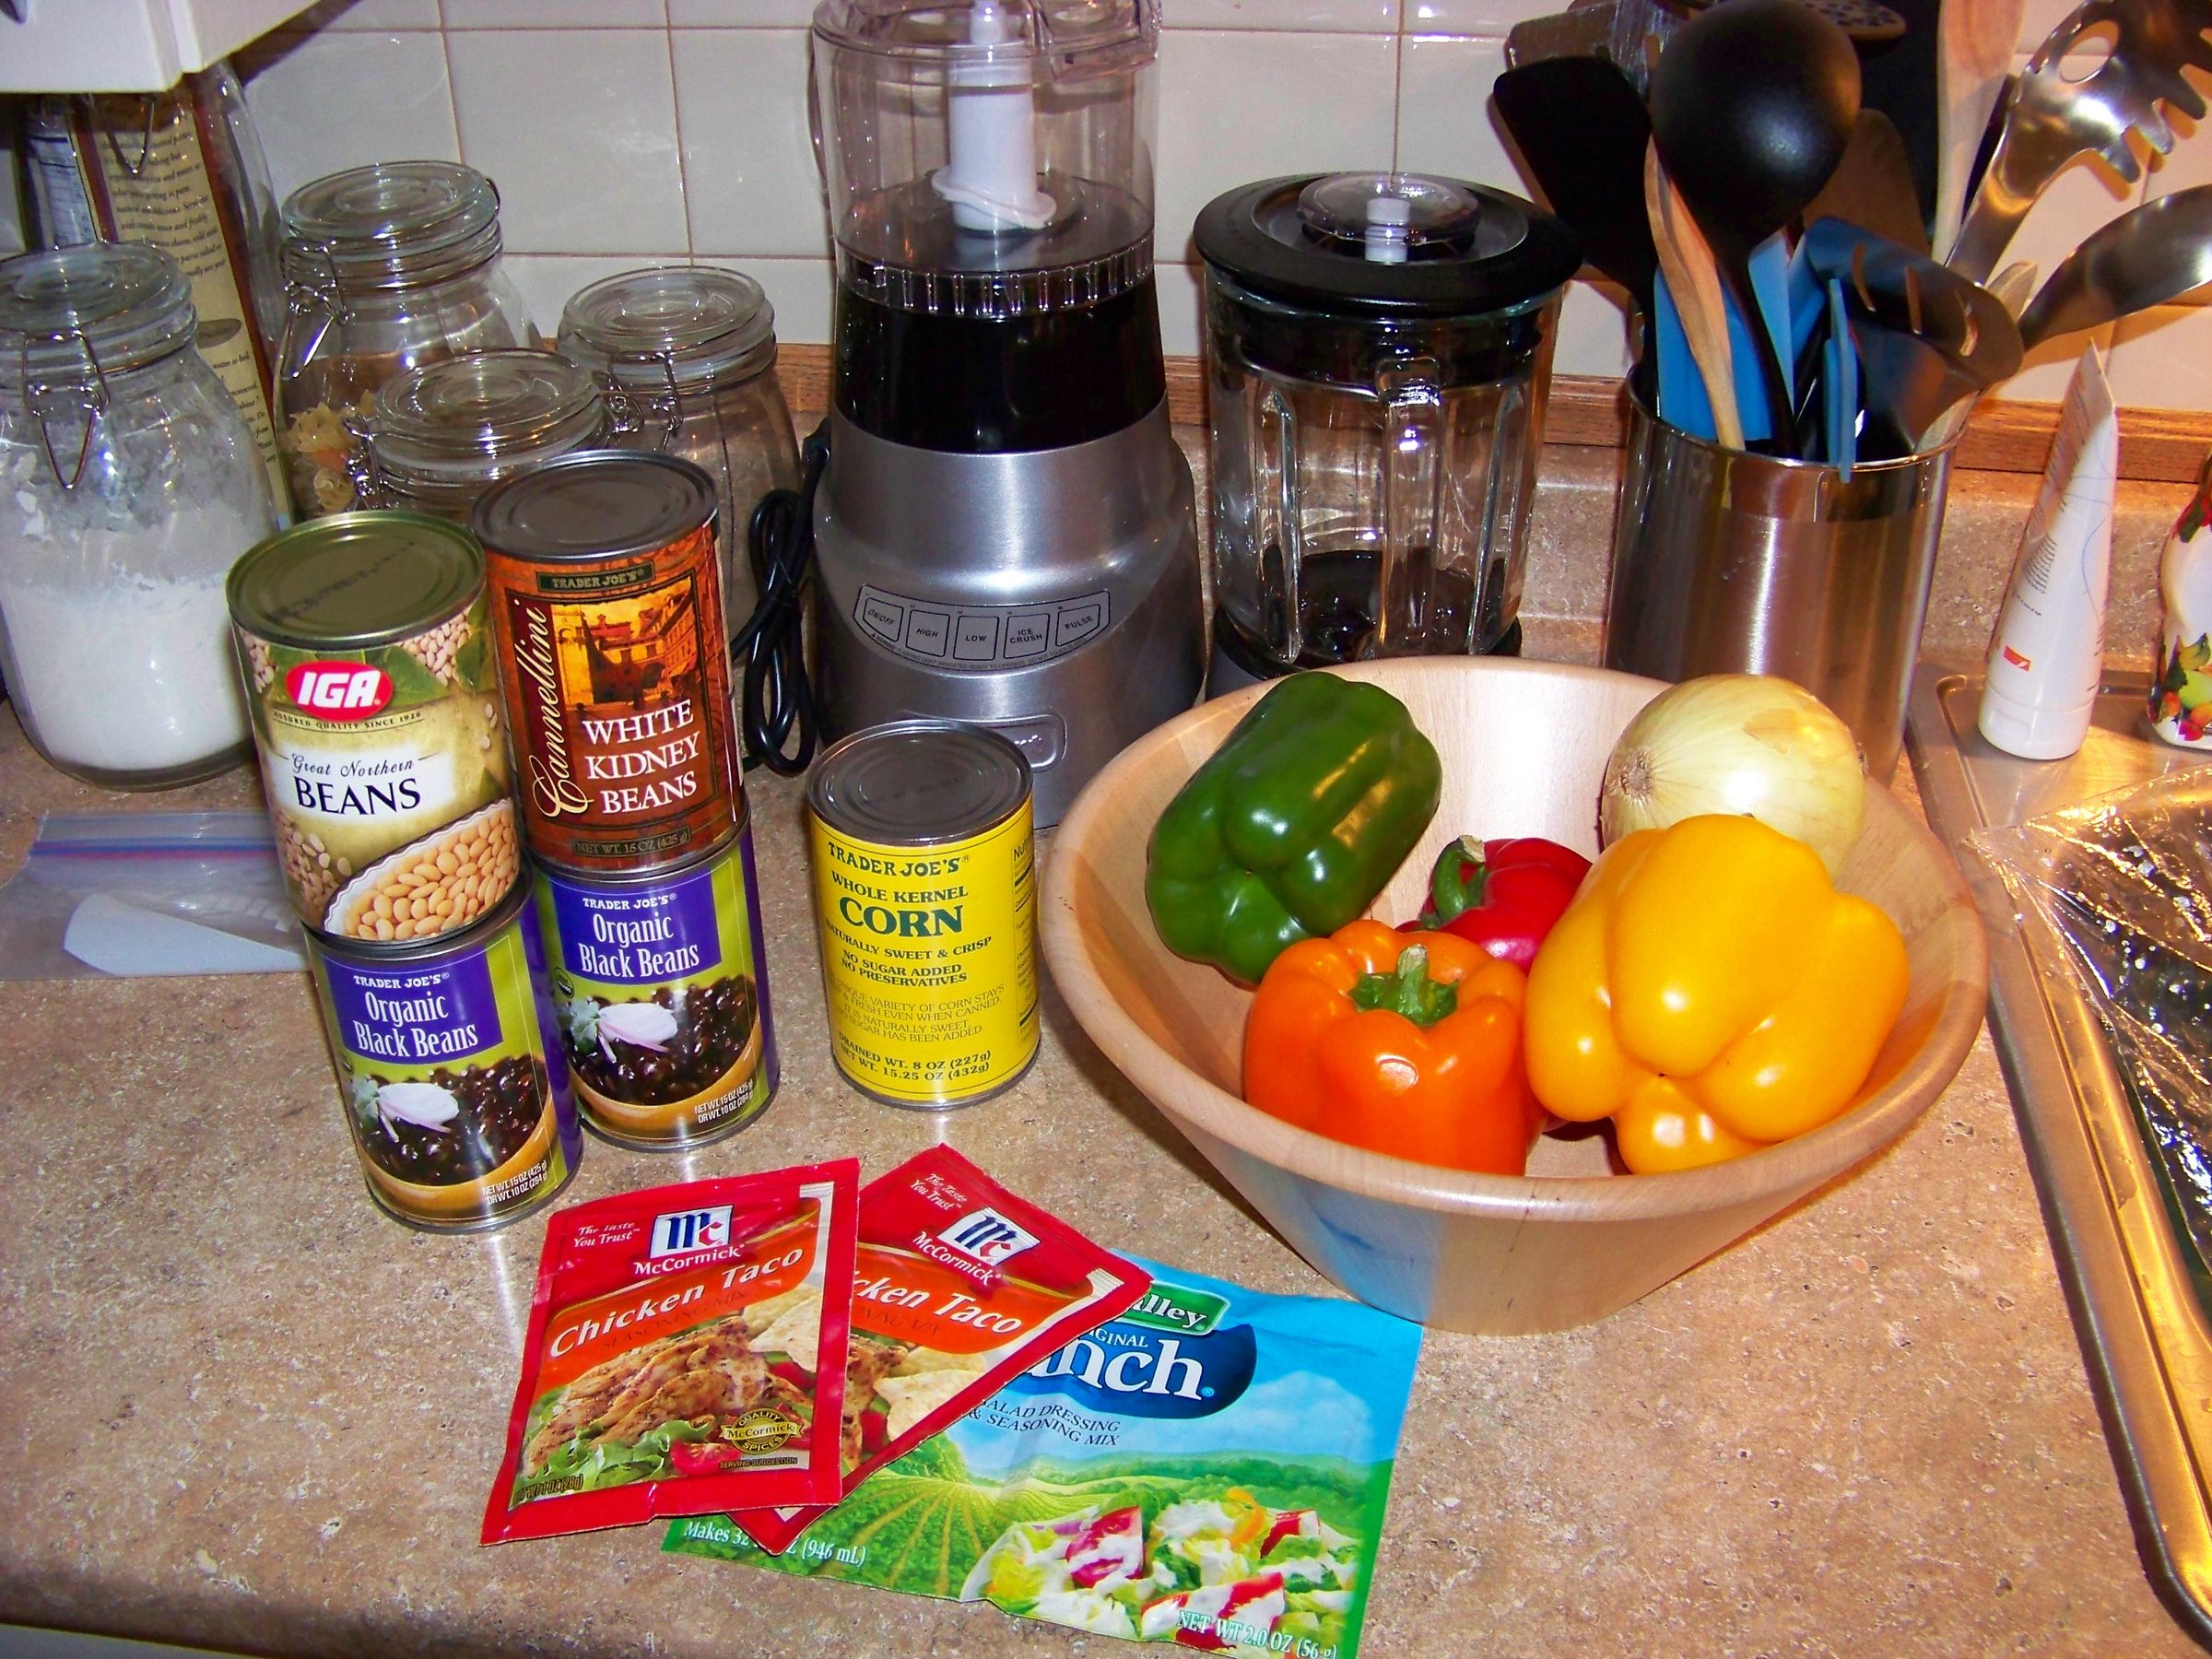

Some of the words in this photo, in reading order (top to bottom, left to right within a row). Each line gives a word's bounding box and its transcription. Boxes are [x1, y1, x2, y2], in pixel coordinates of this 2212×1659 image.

[552, 578, 601, 589] TRADER
[916, 628, 939, 638] HIGH
[1018, 628, 1033, 636] ICE
[1064, 615, 1094, 629] PULSE
[1009, 634, 1043, 644] CRUSH
[298, 670, 381, 708] IGA
[274, 711, 311, 726] ASSURED
[316, 721, 359, 730] QUALITY
[365, 718, 394, 728] SINCE
[582, 699, 694, 746] WHITE
[291, 753, 331, 775] Great
[340, 759, 413, 777] Northern
[585, 731, 700, 780] KIDNEY
[293, 775, 421, 815] BEANS
[600, 771, 698, 815] BEANS
[576, 841, 598, 853] NET
[638, 840, 656, 852] OZ
[828, 841, 897, 877] TRADER
[900, 857, 960, 877] JOE'S
[831, 870, 888, 901] WHOLE
[894, 886, 969, 903] KERNEL
[582, 898, 630, 910] TRADER
[633, 895, 669, 909] JOE'S
[593, 912, 674, 948] Organic
[840, 896, 964, 937] CORN
[578, 942, 635, 978] Black
[636, 944, 700, 978] Beans
[885, 948, 933, 959] SWEET
[937, 949, 948, 959] &
[953, 935, 993, 956] CRISP
[841, 958, 856, 972] NO
[859, 969, 967, 987] PRESERVATIVES
[843, 950, 859, 963] NO
[862, 959, 907, 976] SUGAR
[911, 964, 961, 977] ADDED
[353, 975, 402, 989] TRADER
[404, 973, 441, 988] JOE'S
[365, 991, 449, 1028] Organic
[870, 996, 915, 1012] VARIETY
[919, 1003, 935, 1012] OF
[938, 997, 971, 1011] CORN
[974, 983, 1005, 1003] STAYS
[863, 1014, 927, 1033] NATURALLY
[884, 1009, 913, 1021] EVEN
[917, 1011, 952, 1021] WHEN
[352, 1019, 411, 1057] Black
[410, 1024, 478, 1057] Beans
[883, 1030, 907, 1041] HAS
[910, 1033, 940, 1042] BEEN
[943, 1025, 982, 1041] ADDED
[839, 1031, 881, 1062] DRAINED
[885, 1057, 908, 1069] WT.
[913, 1061, 921, 1070] 8
[926, 1061, 946, 1069] OZ
[950, 1050, 991, 1070] (227g)
[841, 1043, 856, 1061] NET
[859, 1058, 877, 1072] WT.
[883, 1067, 920, 1081] 15.25
[924, 1072, 945, 1081] OZ
[947, 1062, 990, 1081] (432g)
[694, 1103, 707, 1114] NET
[728, 1089, 736, 1101] OZ
[698, 1113, 708, 1124] DR
[721, 1105, 729, 1115] 10
[728, 1100, 737, 1112] OZ
[482, 1185, 496, 1196] NET
[518, 1171, 528, 1183] OZ
[487, 1193, 498, 1205] DR
[512, 1187, 520, 1197] 10
[520, 1182, 530, 1193] OZ
[910, 1180, 929, 1195] You
[927, 1190, 955, 1211] Trust
[573, 1237, 595, 1248] You
[598, 1231, 633, 1244] Trust
[633, 1247, 743, 1276] McCormick
[912, 1230, 994, 1286] McCormick
[550, 1284, 705, 1358] Chicken
[722, 1248, 805, 1290] Taco
[853, 1271, 931, 1309] cken
[934, 1292, 1023, 1335] Taco
[1088, 1327, 1149, 1348] IGINAL
[1030, 1339, 1203, 1401] anch
[727, 1423, 794, 1439] McCormick
[738, 1411, 781, 1427] QUALITY
[969, 1407, 982, 1420] &
[986, 1414, 1082, 1442] SEASONING
[1084, 1434, 1121, 1446] MIX
[1039, 1405, 1121, 1432] DRESSING
[742, 1436, 782, 1452] SPICES
[720, 1459, 750, 1469] SERVING
[752, 1456, 798, 1467] SUGGESTION
[684, 1521, 730, 1543] Makes
[802, 1537, 834, 1560] (946
[1177, 1610, 1212, 1634] NET
[1215, 1618, 1244, 1641] WT
[1243, 1625, 1269, 1648] 2.0
[1270, 1631, 1293, 1654] OZ
[1296, 1637, 1319, 1659] (56
